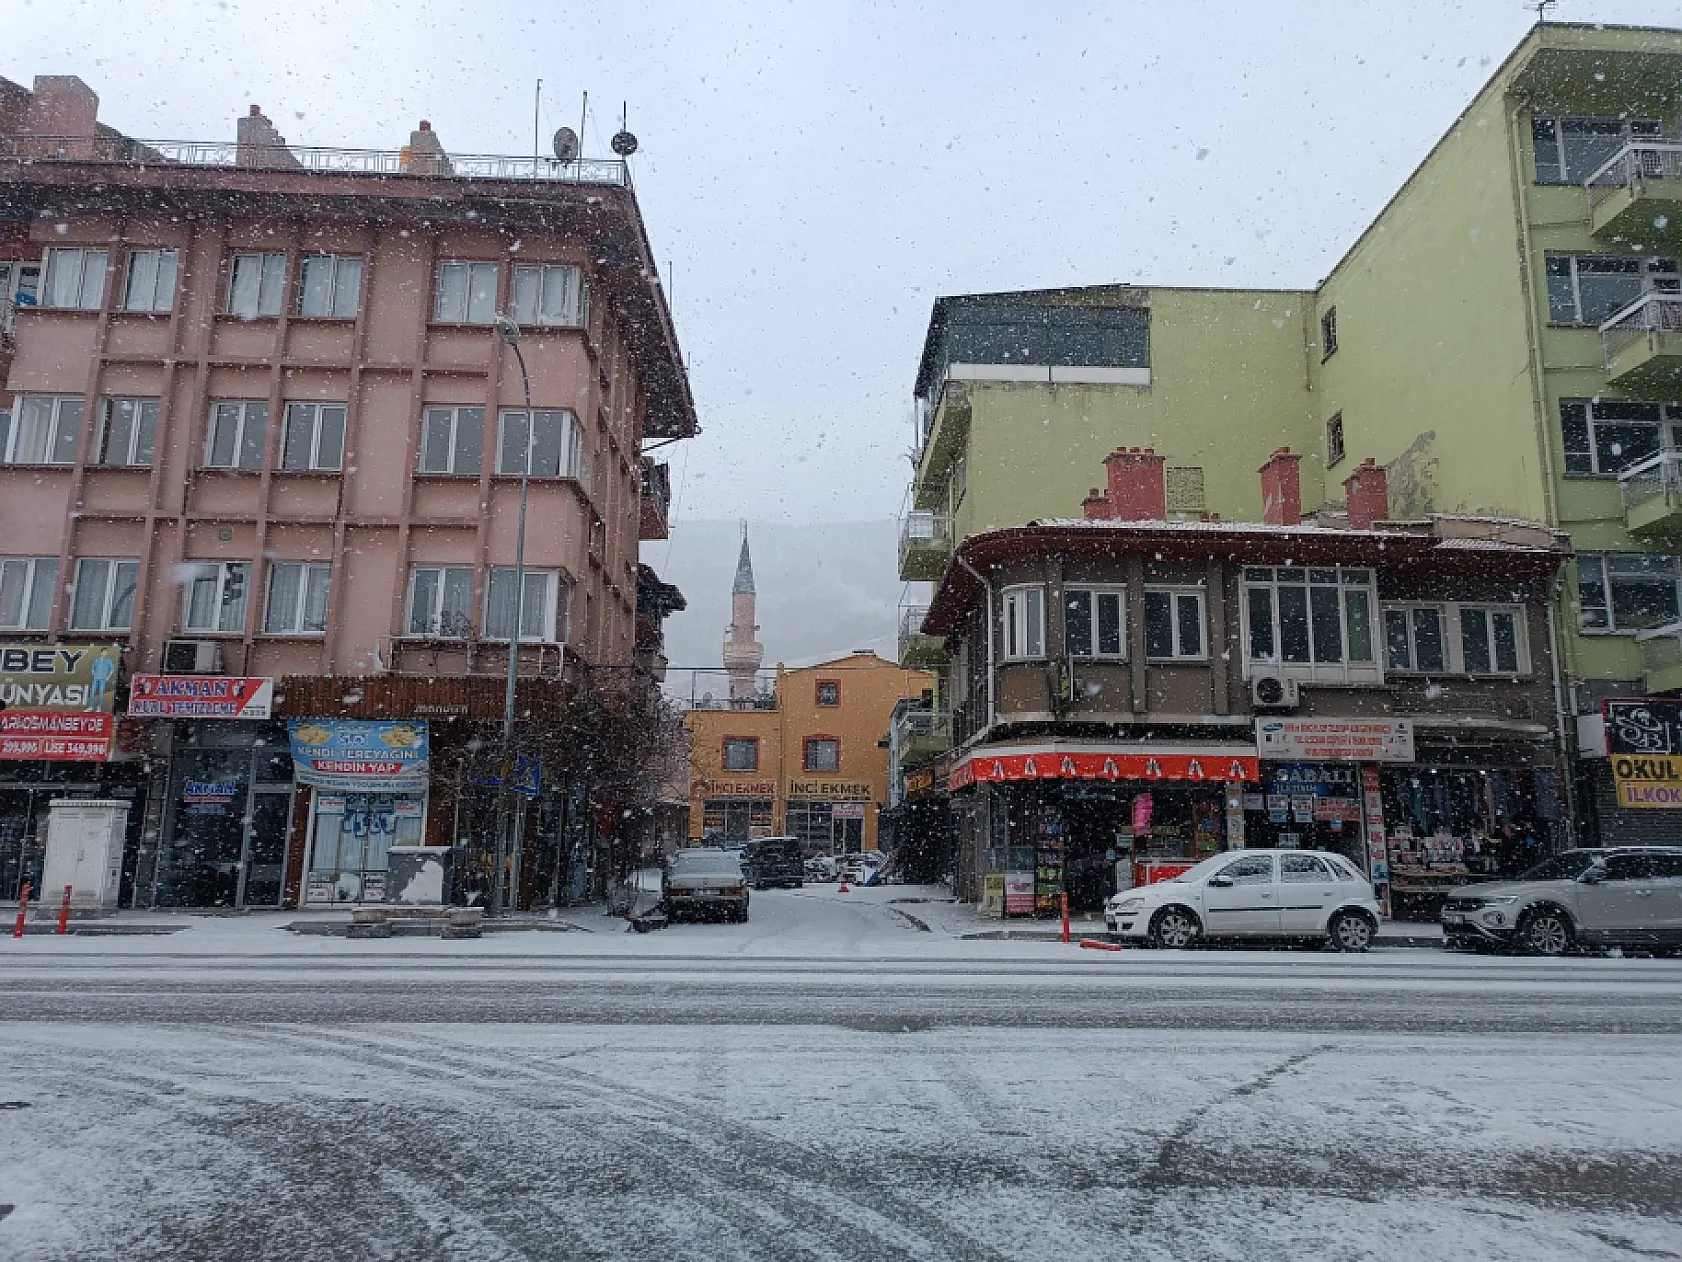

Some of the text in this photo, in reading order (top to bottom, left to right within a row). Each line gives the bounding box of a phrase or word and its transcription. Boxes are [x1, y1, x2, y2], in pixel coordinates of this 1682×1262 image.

[153, 680, 228, 698] AKMAN
[1617, 759, 1679, 779] OKUL
[735, 783, 775, 794] EKMEK
[790, 779, 871, 795] İNCİ EKMEK
